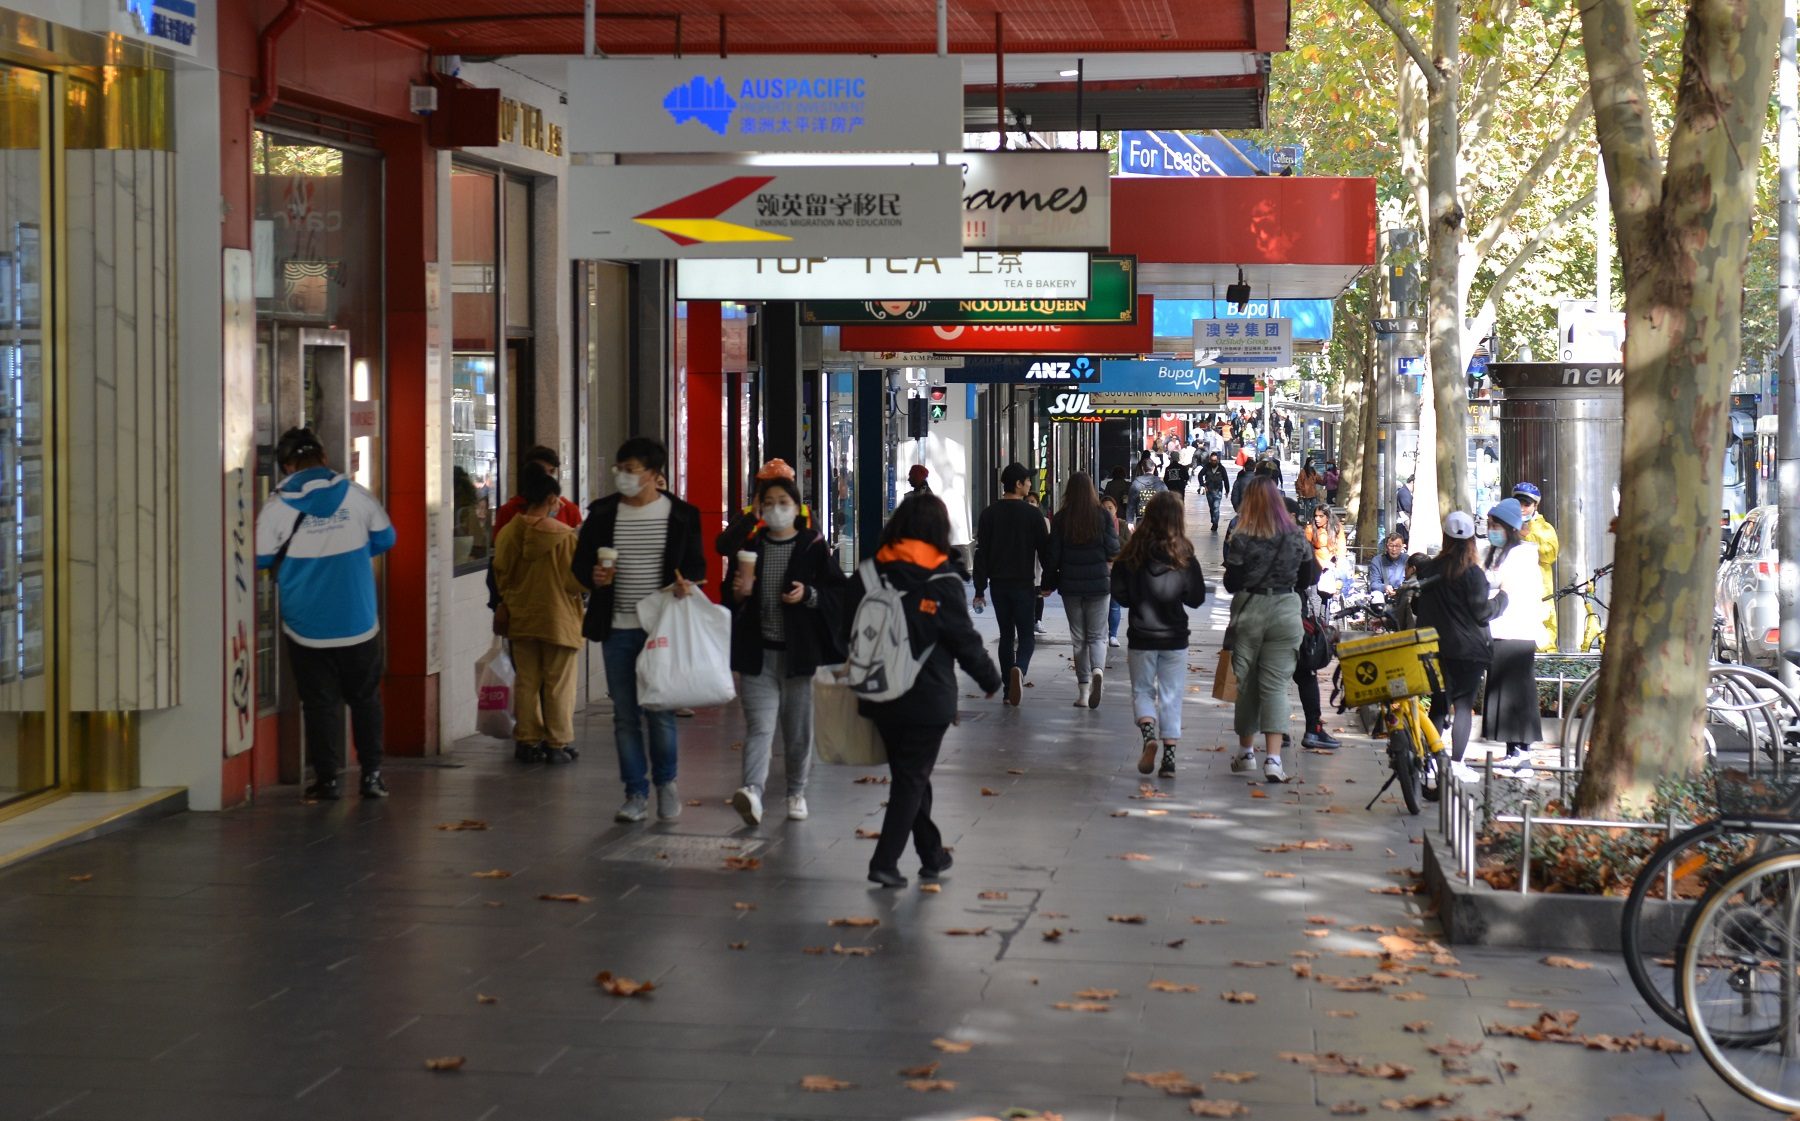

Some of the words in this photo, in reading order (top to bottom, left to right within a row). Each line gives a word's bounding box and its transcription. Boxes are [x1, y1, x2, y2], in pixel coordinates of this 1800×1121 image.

[740, 78, 865, 98] AUSPACIFIC
[740, 117, 864, 133] 澳洲太平洋房产
[1130, 141, 1158, 168] For
[1164, 143, 1210, 173] Lease
[963, 163, 1087, 213] ames
[756, 193, 901, 217] 领英留学移民
[755, 219, 788, 227] LINKING
[790, 219, 834, 227] MIGRATION
[837, 219, 854, 227] AND
[856, 219, 902, 227] EDUCATION
[1004, 280, 1025, 288] TEA
[1036, 280, 1077, 288] BAKERY
[959, 300, 1028, 312] NOODLE
[1030, 300, 1087, 315] QUEEN
[1206, 323, 1279, 337] 澳学集团
[1025, 362, 1071, 379] ANZ
[1159, 366, 1193, 381] Bupa
[1562, 368, 1625, 385] new
